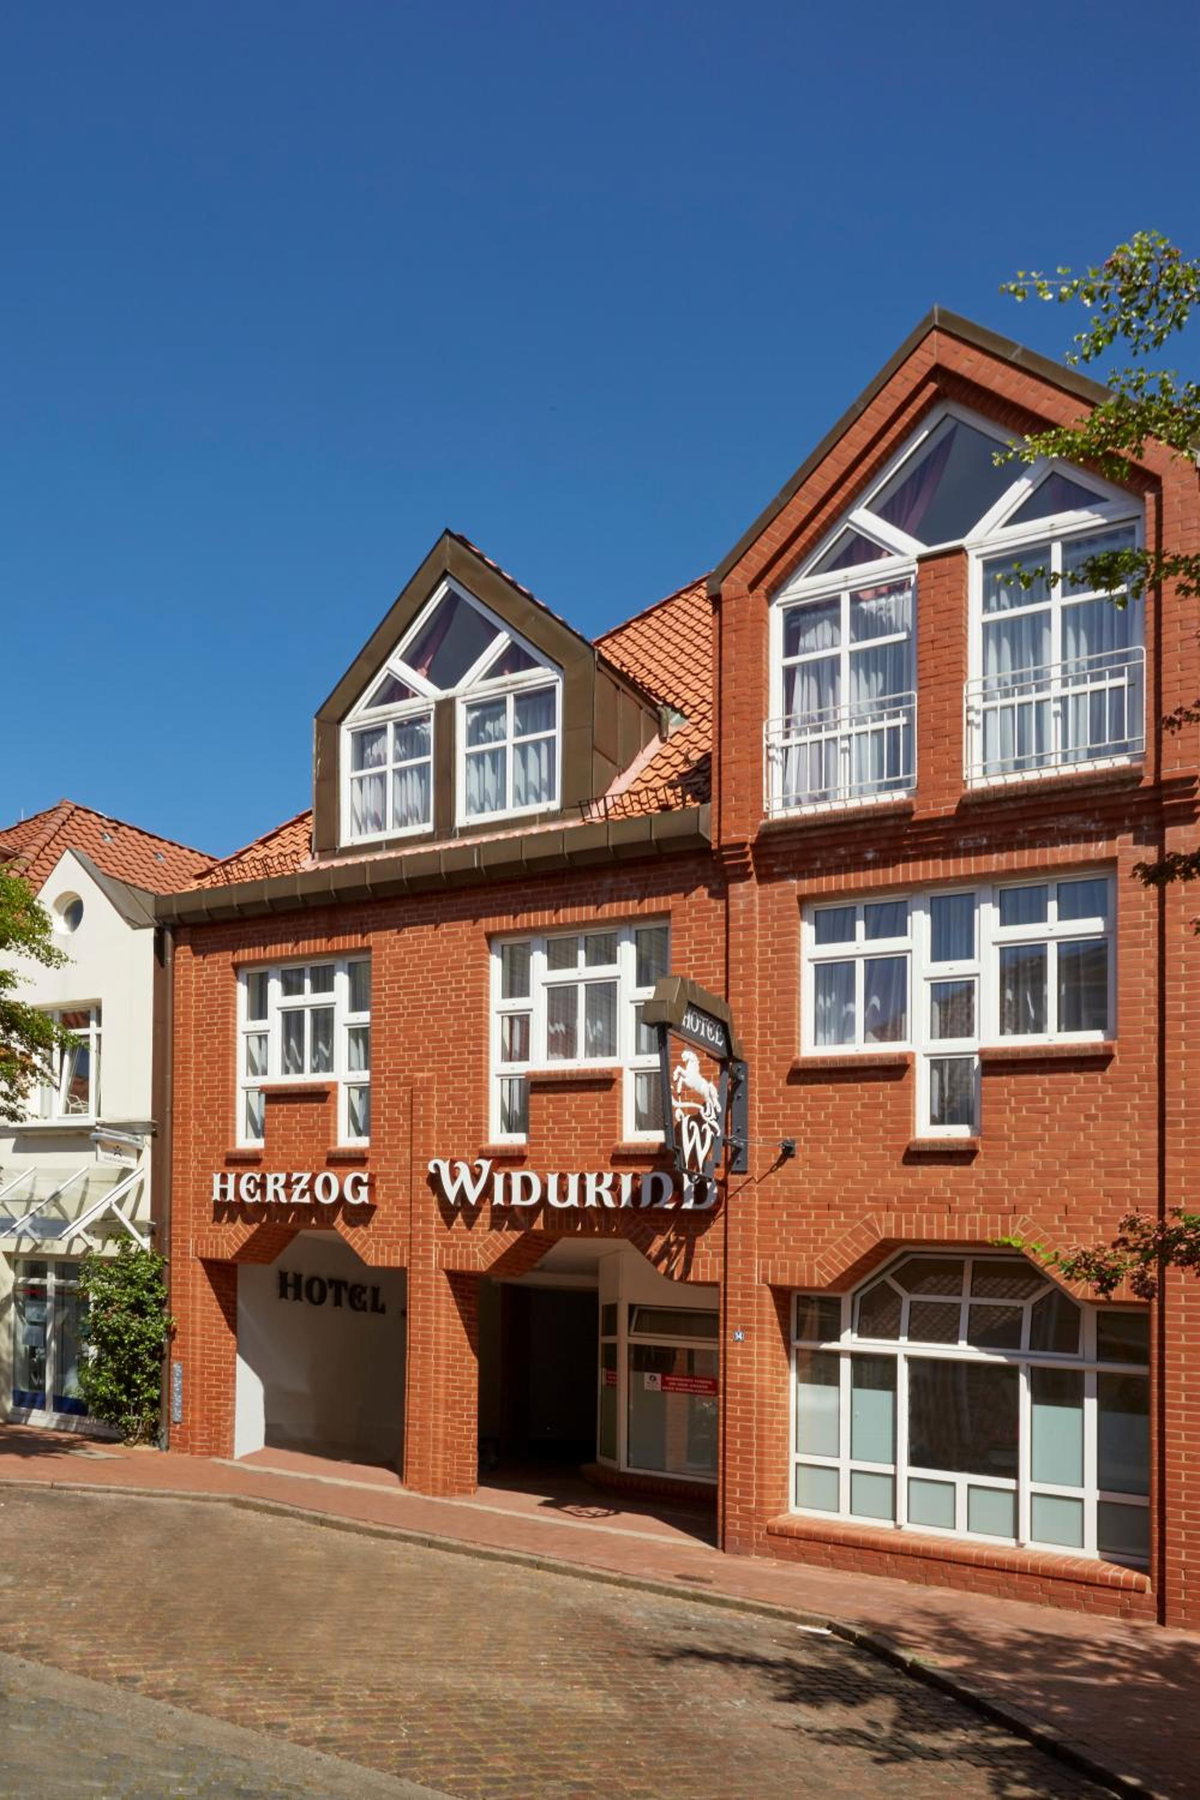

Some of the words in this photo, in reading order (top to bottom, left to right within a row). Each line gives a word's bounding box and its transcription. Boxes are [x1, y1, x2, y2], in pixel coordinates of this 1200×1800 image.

[681, 1009, 724, 1047] HOTEL
[212, 1172, 370, 1204] HERZOG
[427, 1158, 719, 1210] WIDUKIND
[278, 1270, 386, 1315] HOTEL
